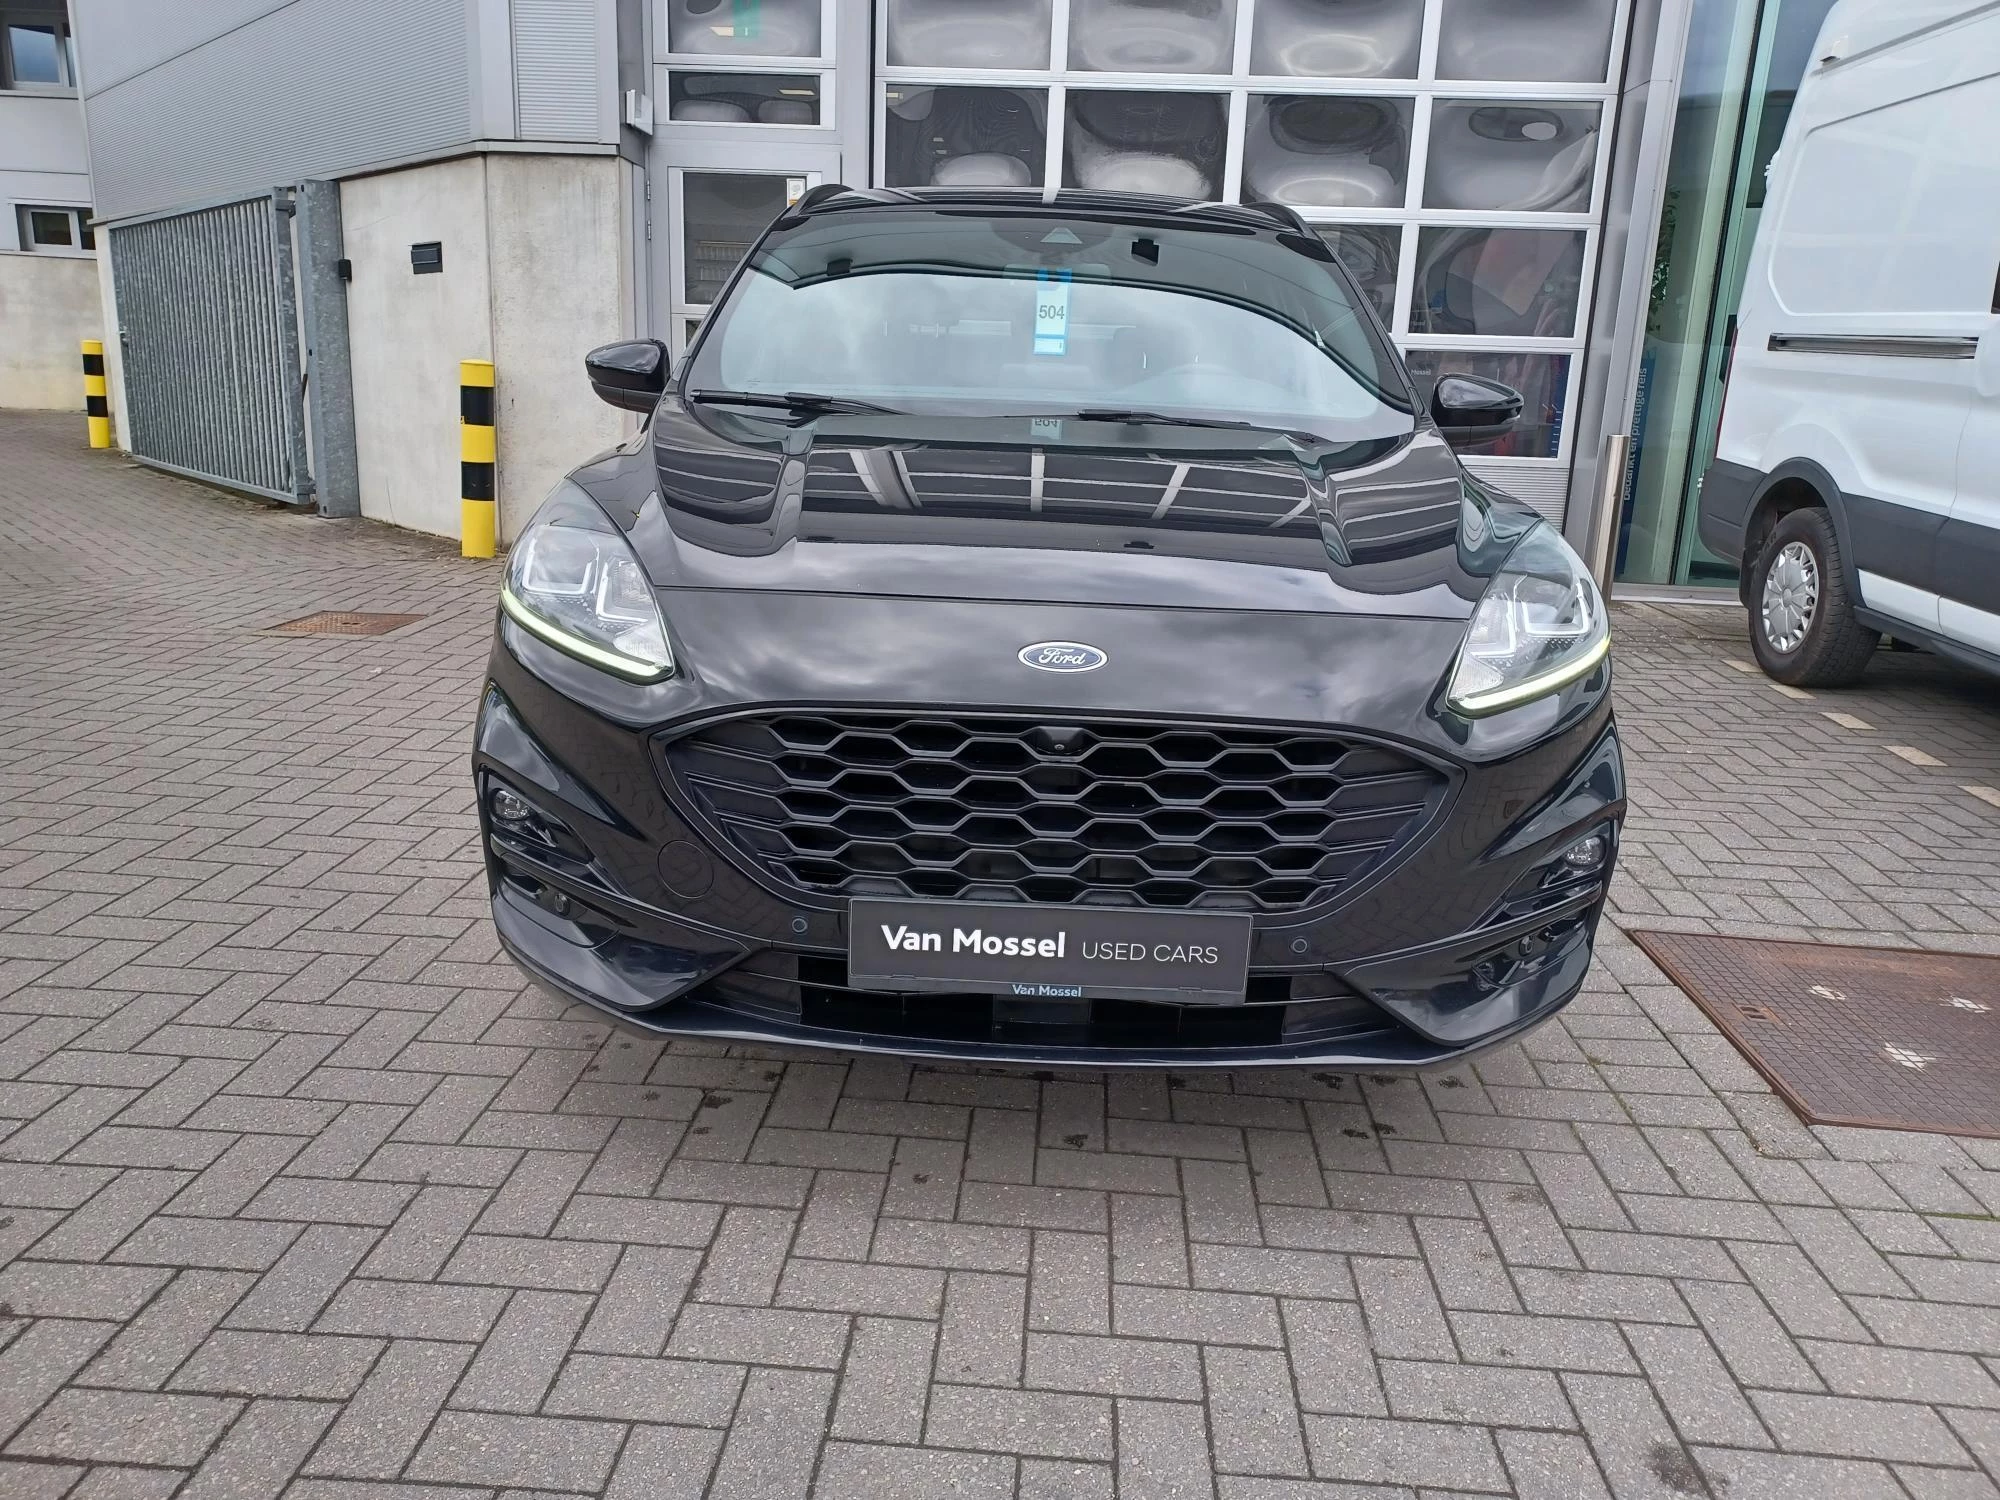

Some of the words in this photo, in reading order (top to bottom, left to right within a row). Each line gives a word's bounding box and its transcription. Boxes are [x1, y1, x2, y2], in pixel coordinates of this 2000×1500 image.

[1038, 304, 1065, 320] 504
[1631, 391, 1645, 435] prettige
[1638, 368, 1647, 389] reis
[1038, 647, 1086, 665] Ford
[880, 924, 941, 952] Van
[952, 928, 1066, 958] Mossel
[1082, 941, 1146, 961] USED
[1153, 944, 1219, 964] CARS
[1012, 984, 1037, 996] Van
[1038, 985, 1082, 998] Mossel
